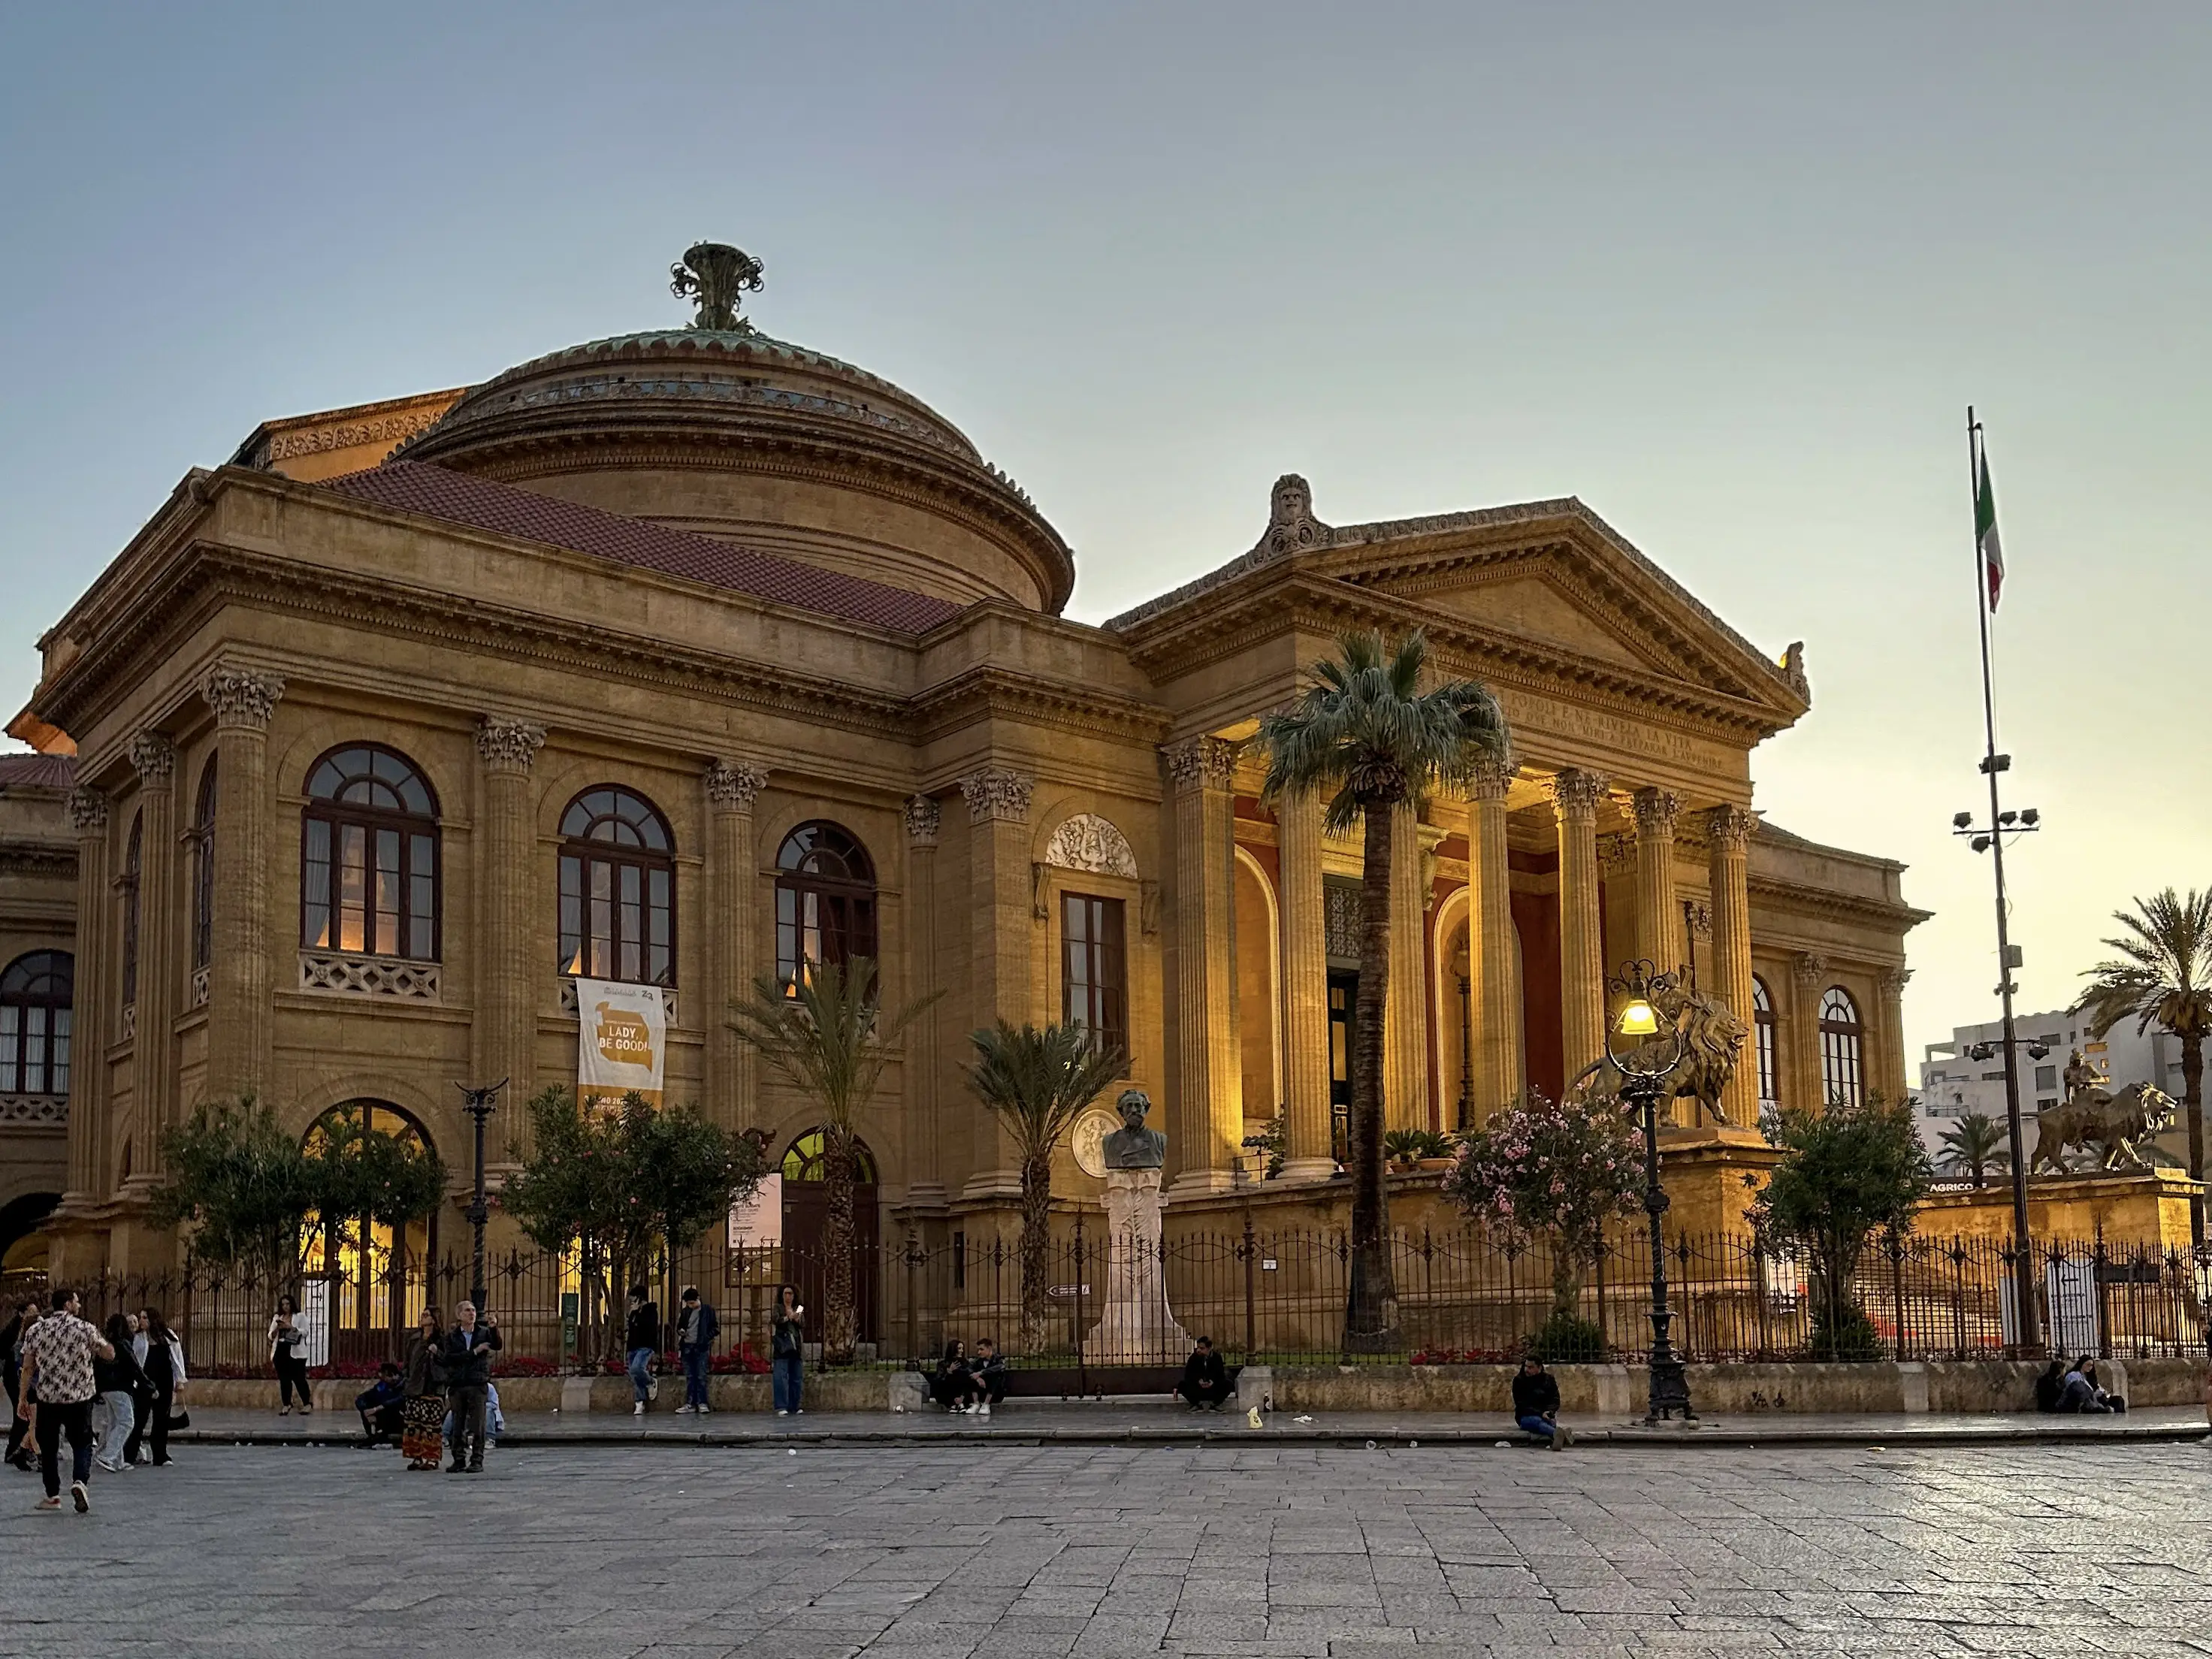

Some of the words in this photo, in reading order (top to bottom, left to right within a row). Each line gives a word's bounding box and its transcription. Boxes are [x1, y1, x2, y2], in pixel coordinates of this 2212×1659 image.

[1665, 732, 1693, 751] VITA
[609, 1025, 639, 1041] LADY,
[599, 1037, 613, 1050] BE
[615, 1039, 648, 1053] GOOD!
